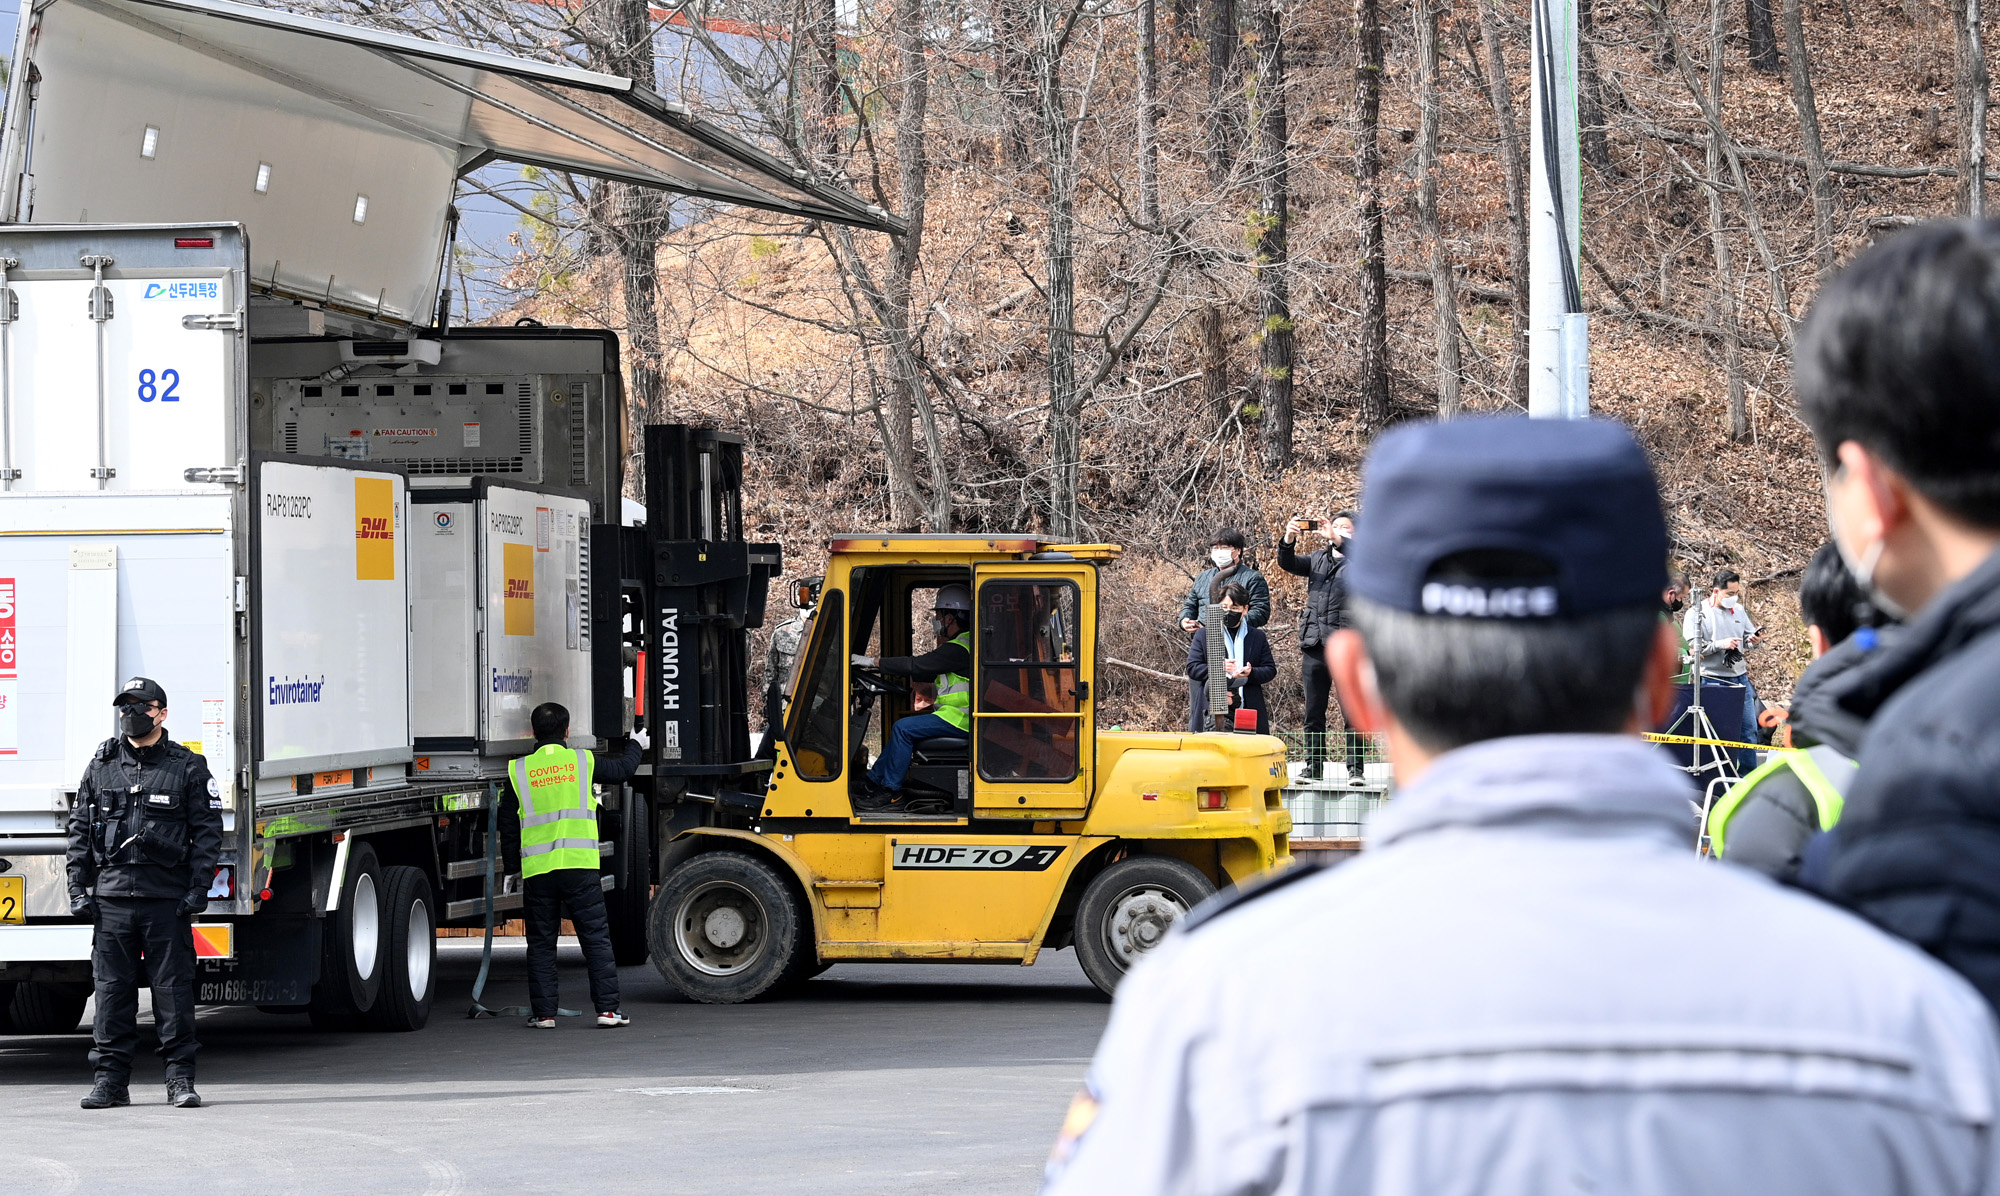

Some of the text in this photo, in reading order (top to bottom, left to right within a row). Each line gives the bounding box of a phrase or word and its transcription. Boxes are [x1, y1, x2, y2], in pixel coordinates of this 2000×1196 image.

[168, 282, 218, 299] 신두리특장
[137, 368, 180, 402] 82
[381, 428, 428, 436] FAN CAUTION
[266, 493, 312, 519] RAP81262PC
[360, 517, 389, 539] DHL
[508, 578, 530, 600] DHL
[1421, 582, 1558, 617] POLICE
[661, 607, 680, 710] HYUNDAI
[529, 763, 575, 778] COVID-19
[531, 773, 576, 788] 백신안전수송
[901, 847, 967, 864] HDF
